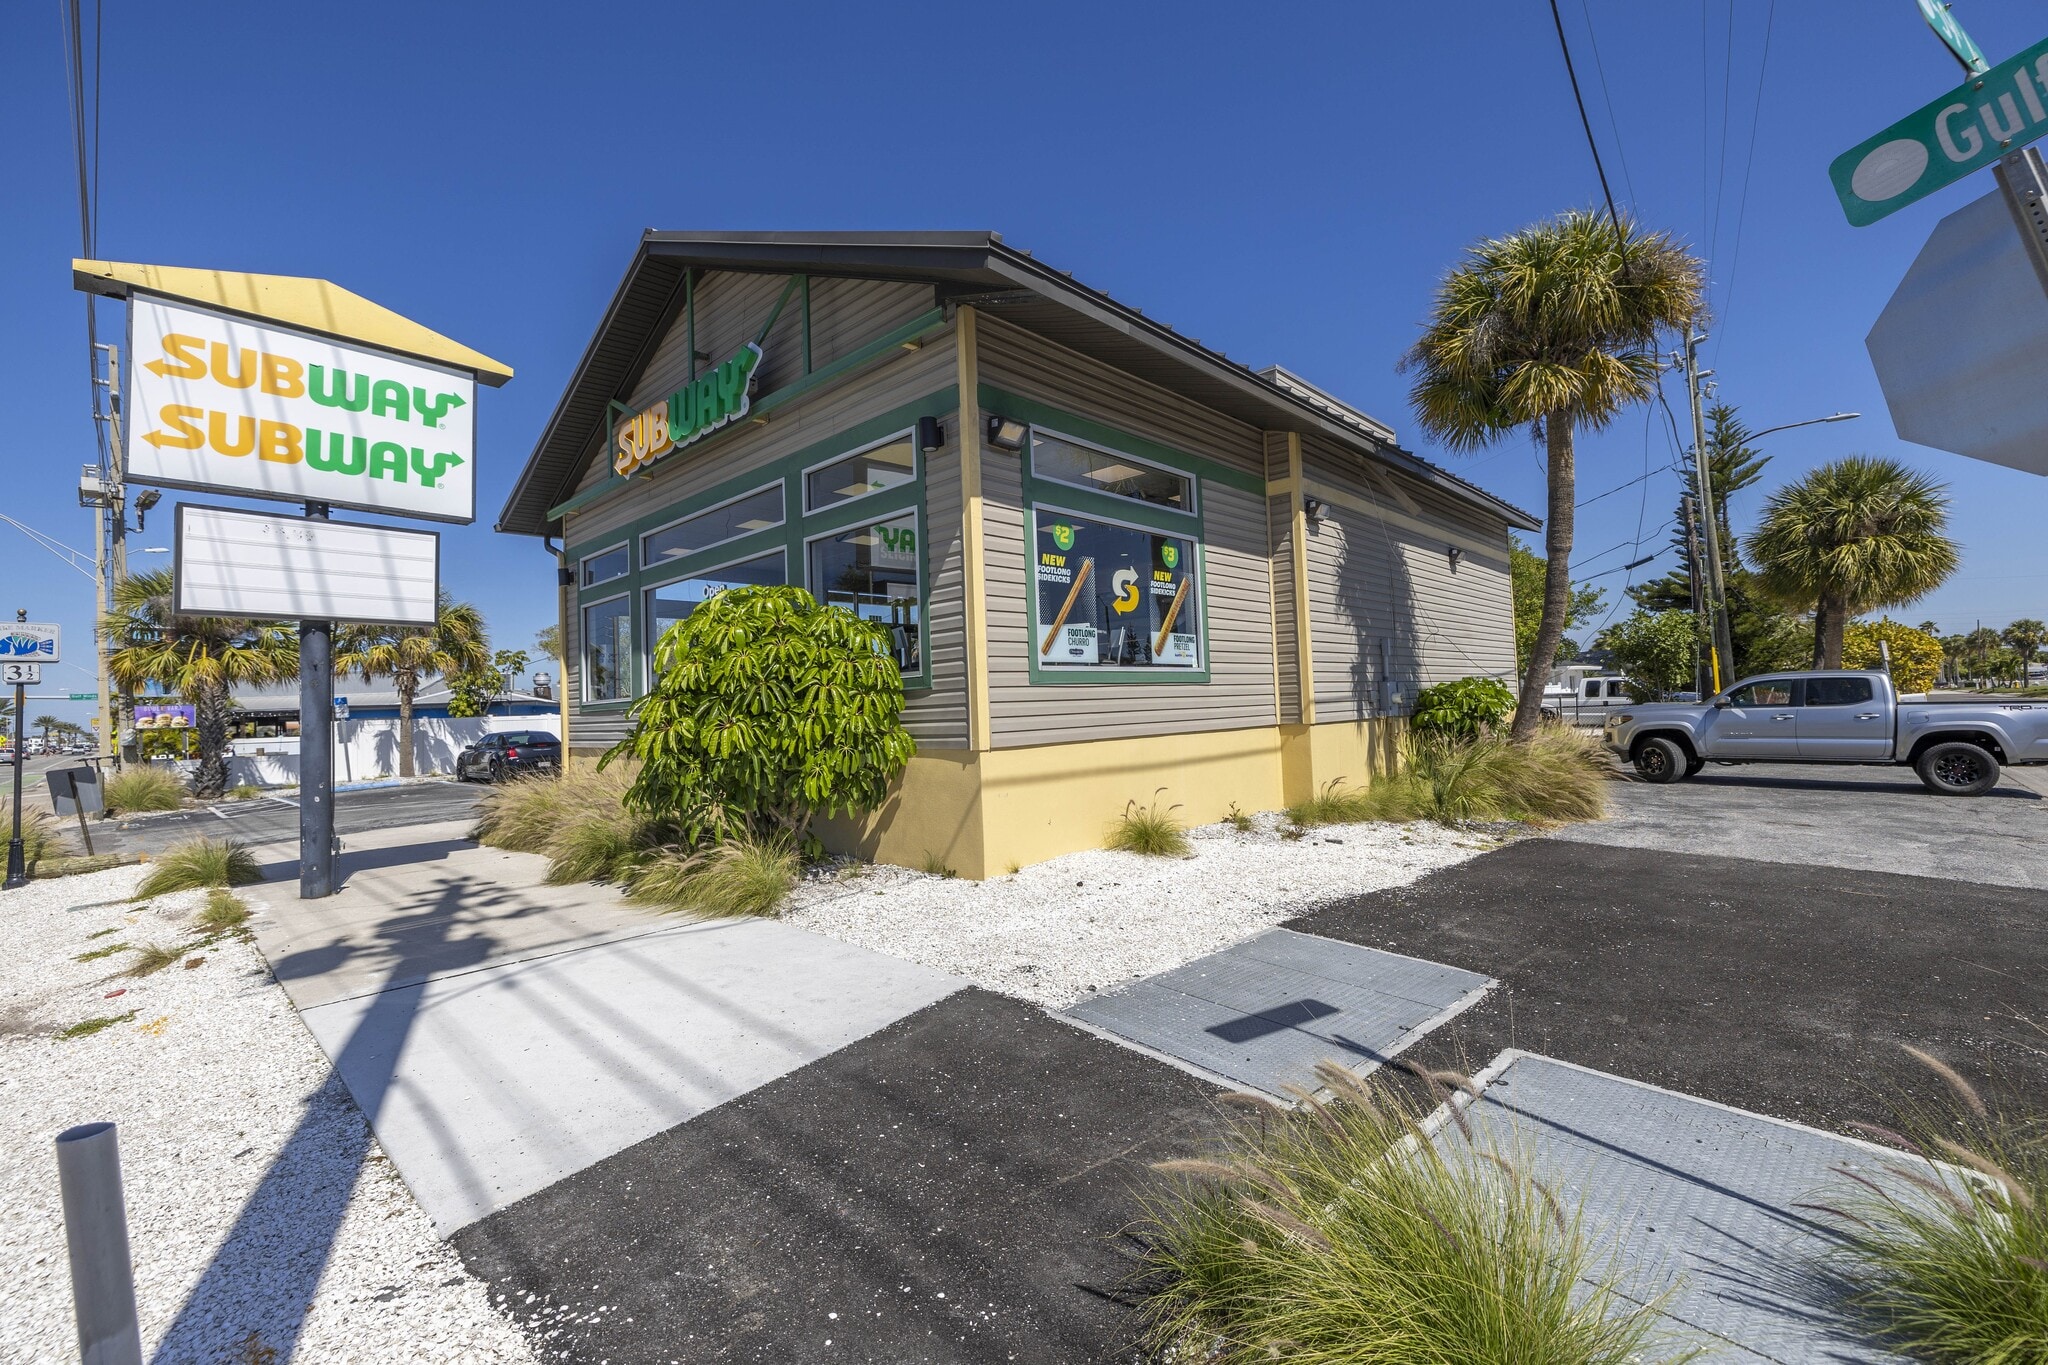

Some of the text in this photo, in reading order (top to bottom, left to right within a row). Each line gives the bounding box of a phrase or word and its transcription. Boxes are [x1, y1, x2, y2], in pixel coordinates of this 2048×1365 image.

[143, 333, 467, 428] SUBWAY
[614, 345, 761, 477] SUBWAY
[141, 403, 466, 488] SUBWAY
[1055, 524, 1069, 544] $2
[1041, 553, 1066, 567] NEW
[1163, 545, 1175, 562] $3
[1038, 565, 1072, 577] FOOTLONG
[1153, 570, 1173, 583] NEW
[1038, 573, 1071, 584] SIDEKICKS
[1150, 580, 1177, 590] FOOTLONG
[703, 584, 725, 601] Open
[1150, 587, 1176, 597] SIDEKICKS
[1068, 629, 1096, 638] FOOTLONG
[1173, 635, 1195, 644] FOOTLONG
[1068, 637, 1090, 647] CHURRO
[1174, 643, 1191, 651] PRETZEL
[7, 665, 22, 680] 3
